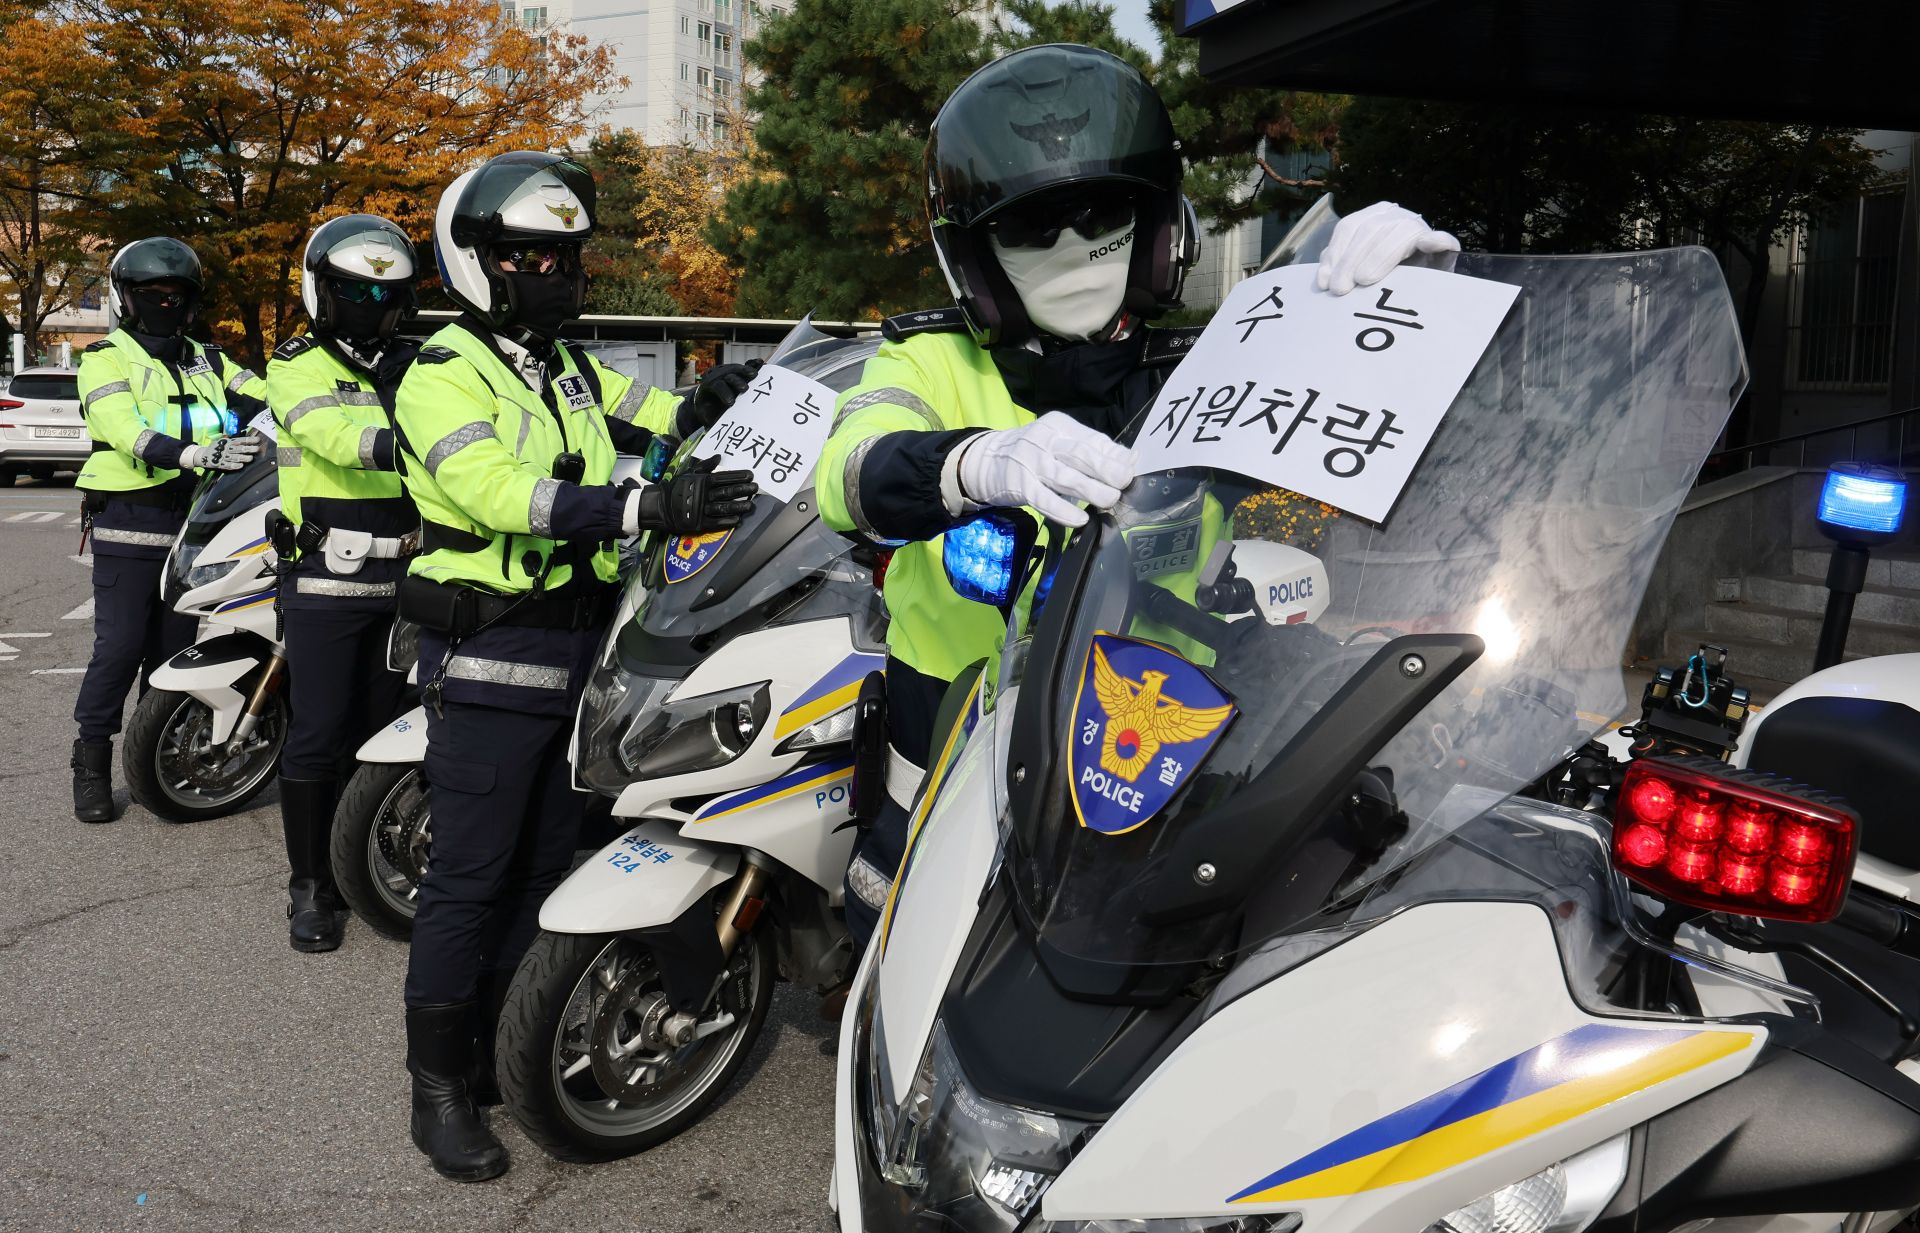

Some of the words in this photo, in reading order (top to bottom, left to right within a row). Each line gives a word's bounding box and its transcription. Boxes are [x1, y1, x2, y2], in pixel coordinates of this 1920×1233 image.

[1236, 286, 1283, 343] 수
[1353, 287, 1425, 352] 능
[570, 394, 592, 407] POLIC
[752, 376, 773, 403] 수
[793, 392, 821, 425] 능
[1150, 381, 1404, 478] 지원차량
[710, 421, 803, 483] 지원차량
[668, 554, 692, 573] POLICE
[1139, 554, 1188, 573] OLICE
[1269, 576, 1313, 606] POLICE
[184, 648, 204, 660] 121
[393, 719, 412, 733] 126
[1082, 718, 1100, 746] 경
[1158, 756, 1182, 787] 찰
[1081, 766, 1144, 814] POLICE
[607, 852, 641, 874] 124
[620, 834, 674, 864] 수원남부
